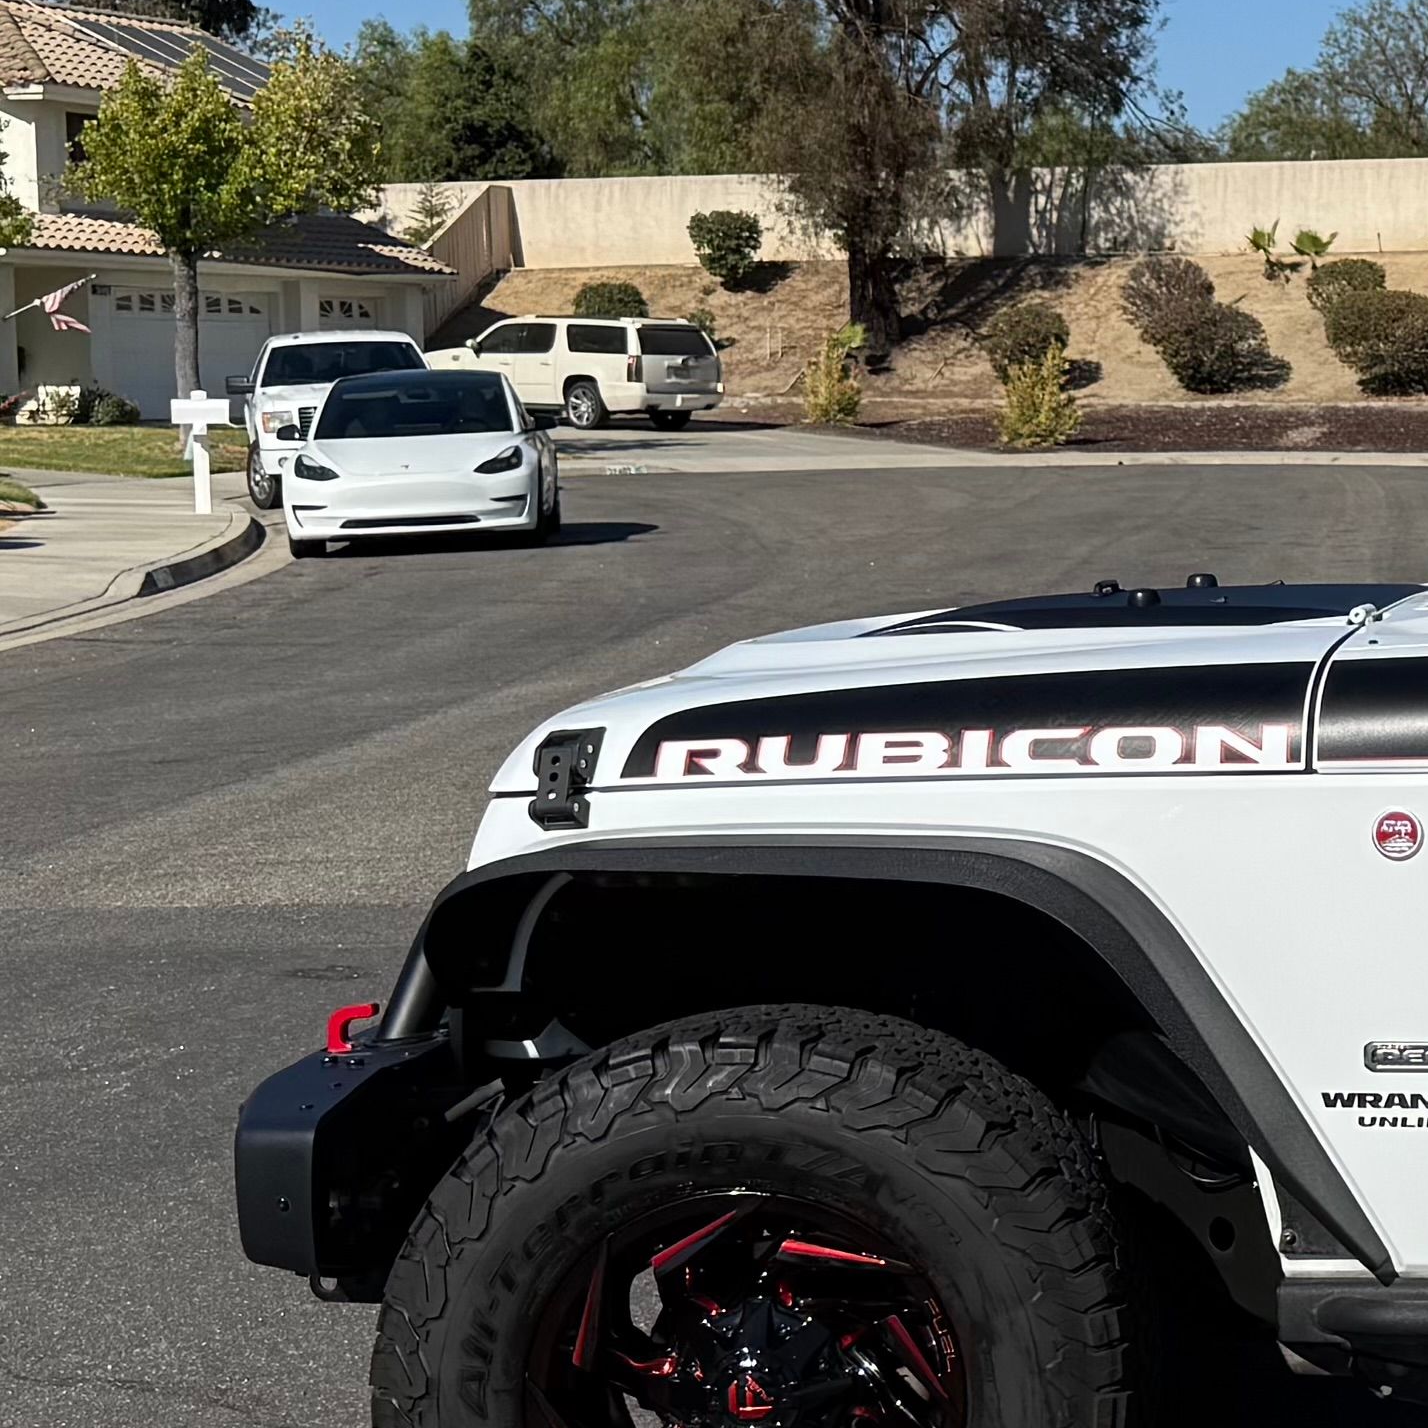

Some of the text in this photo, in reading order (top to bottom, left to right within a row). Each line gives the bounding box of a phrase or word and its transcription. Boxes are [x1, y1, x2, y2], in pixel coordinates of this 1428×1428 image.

[655, 724, 1291, 777] RUBICON
[457, 1139, 744, 1421] All-Terrain
[923, 1296, 957, 1373] FUEL
